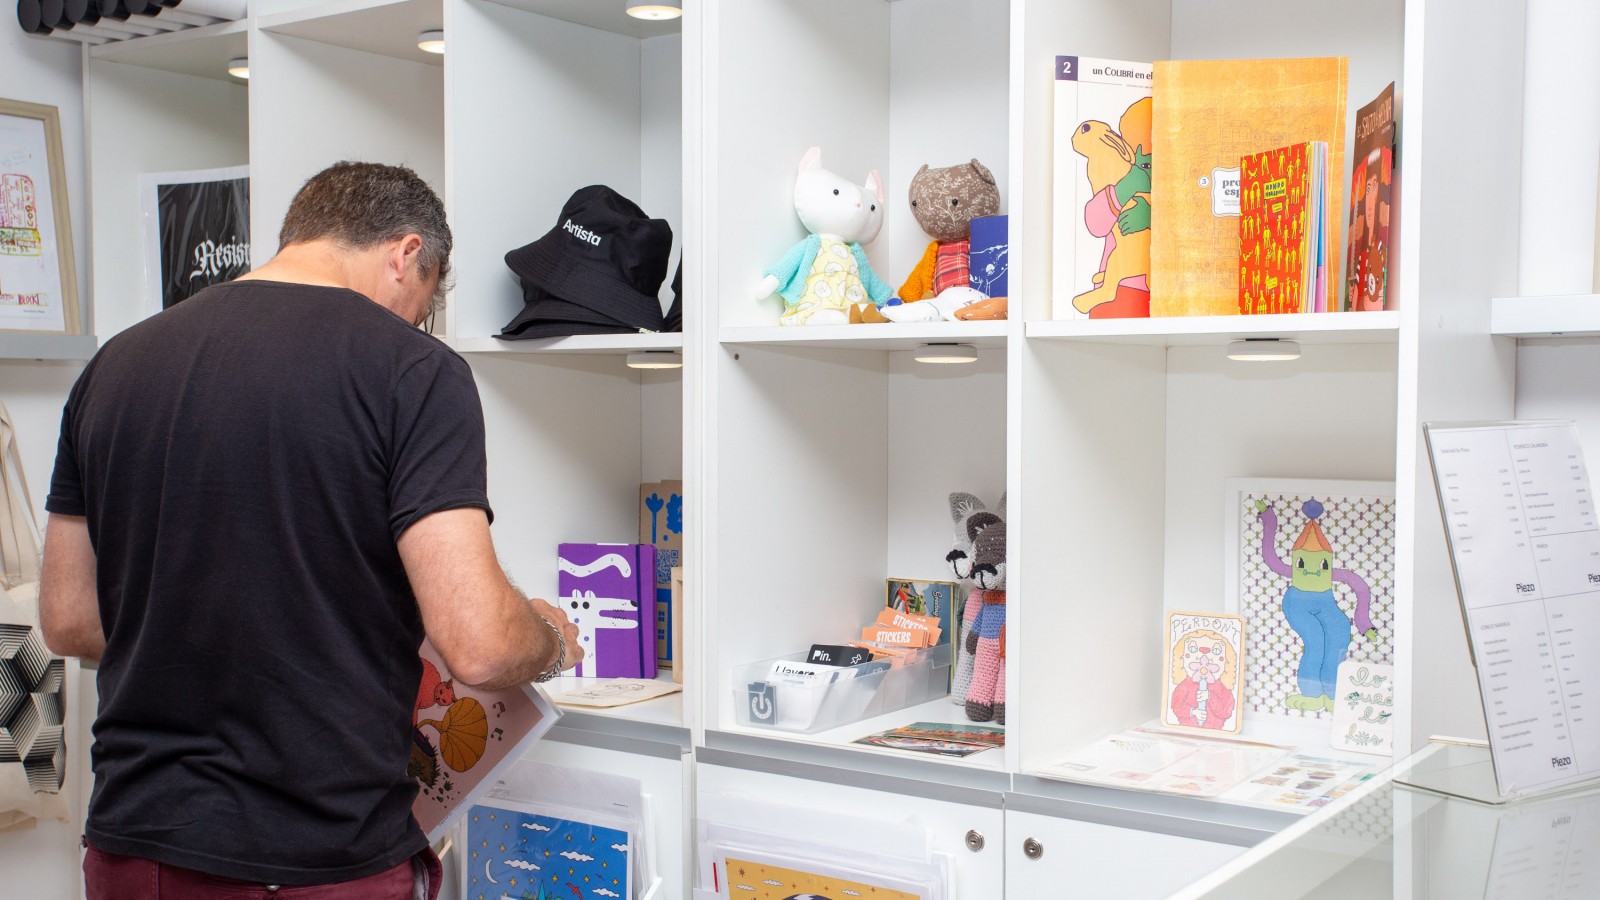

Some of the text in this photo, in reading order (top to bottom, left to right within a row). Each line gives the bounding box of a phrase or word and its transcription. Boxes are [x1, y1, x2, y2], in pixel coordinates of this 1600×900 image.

[1063, 61, 1071, 74] 2
[562, 219, 602, 246] Artista
[876, 631, 911, 643] STICKERS
[812, 650, 831, 661] Pin.
